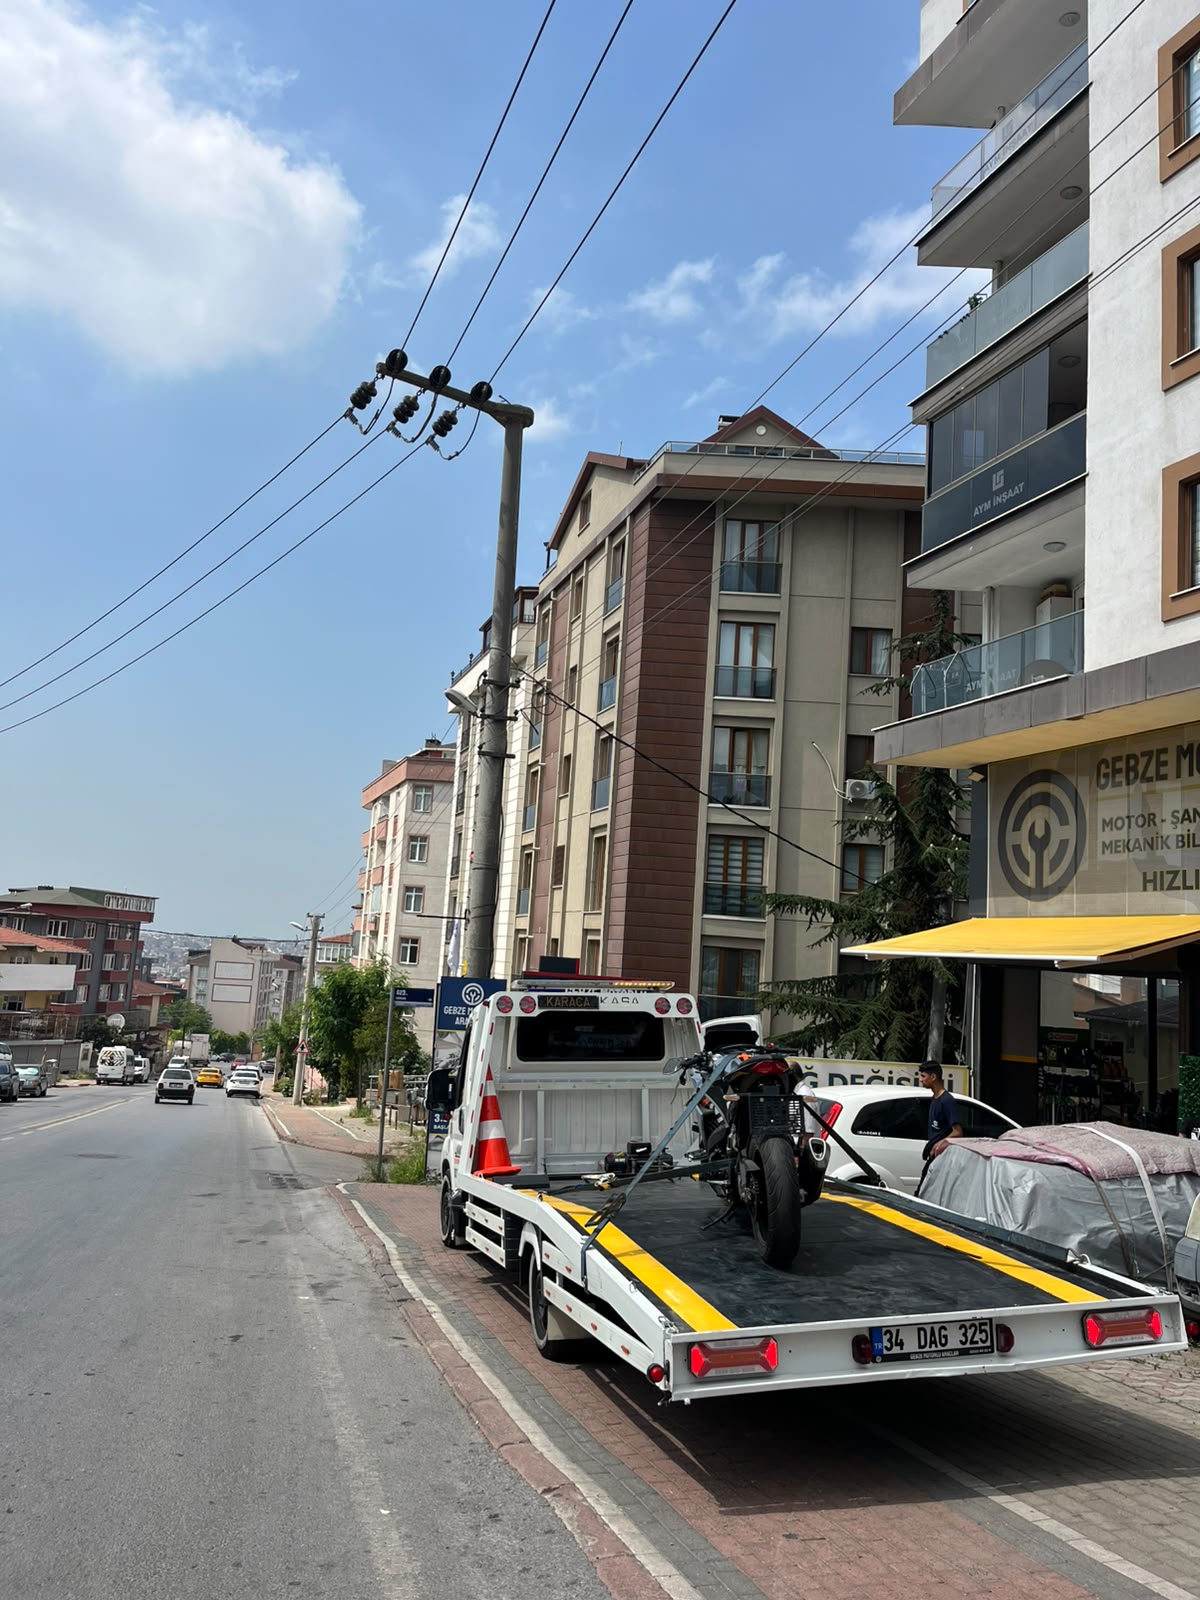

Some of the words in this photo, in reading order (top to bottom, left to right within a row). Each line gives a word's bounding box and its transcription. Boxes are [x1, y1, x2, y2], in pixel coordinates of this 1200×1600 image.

[973, 500, 992, 518] AYM
[993, 481, 1025, 507] İNŞAAT
[1096, 748, 1169, 790] GEBZE
[1176, 742, 1200, 779] M
[1102, 812, 1157, 833] MOTOR
[1102, 832, 1171, 855] MEKANİK
[1176, 829, 1200, 849] BİL
[1142, 869, 1200, 892] HIZLI
[443, 1005, 467, 1015] GEBZE
[545, 996, 591, 1008] KARACA
[874, 1342, 884, 1350] TR
[884, 1328, 905, 1352] 34
[917, 1325, 948, 1350] DAG
[958, 1321, 989, 1346] 325
